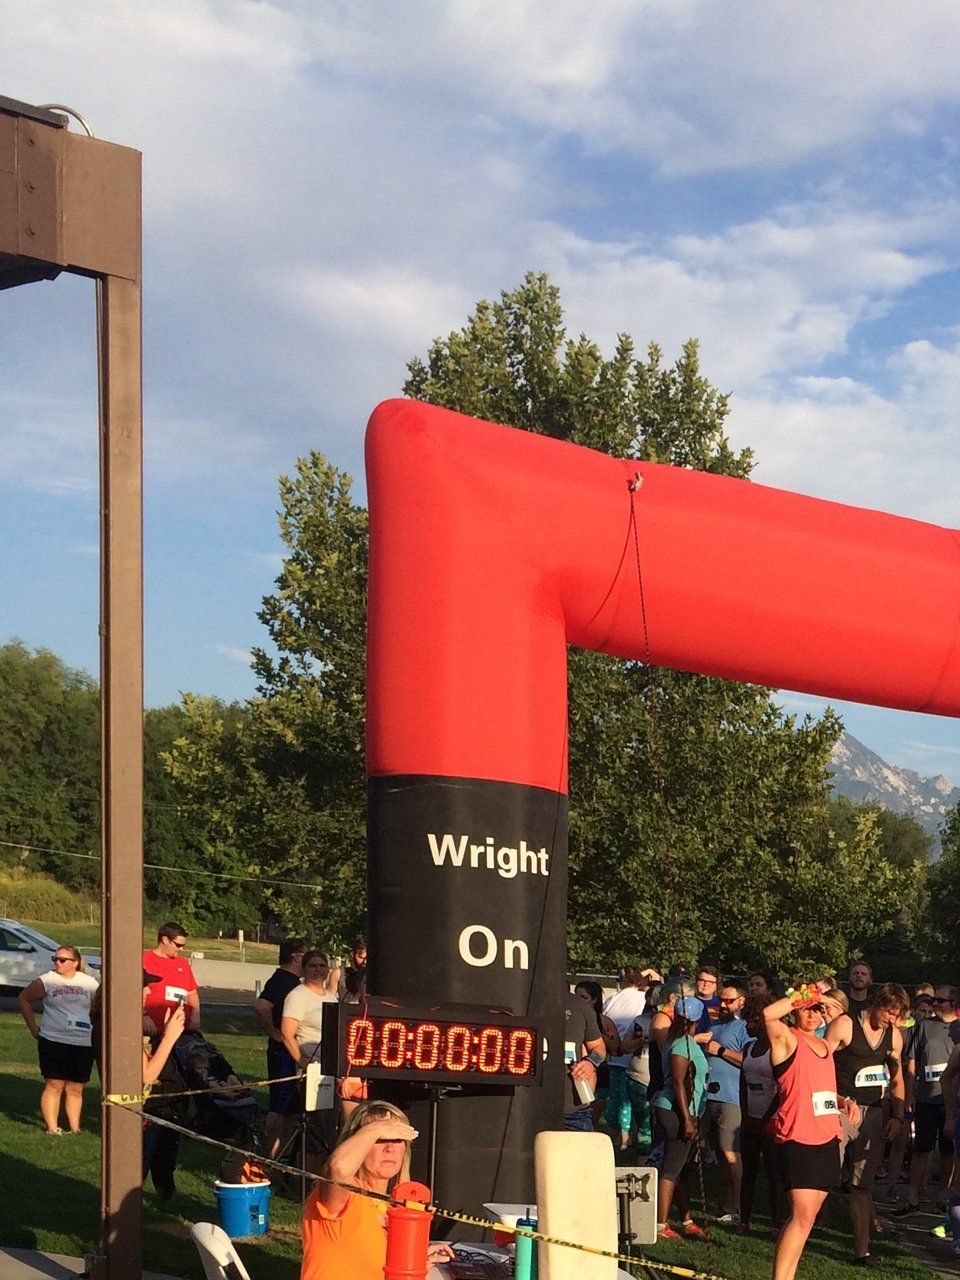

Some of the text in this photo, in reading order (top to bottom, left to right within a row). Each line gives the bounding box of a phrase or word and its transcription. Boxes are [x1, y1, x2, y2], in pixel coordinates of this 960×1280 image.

[427, 833, 549, 878] Wright
[458, 924, 529, 970] On
[347, 1018, 534, 1076] 00:00:00
